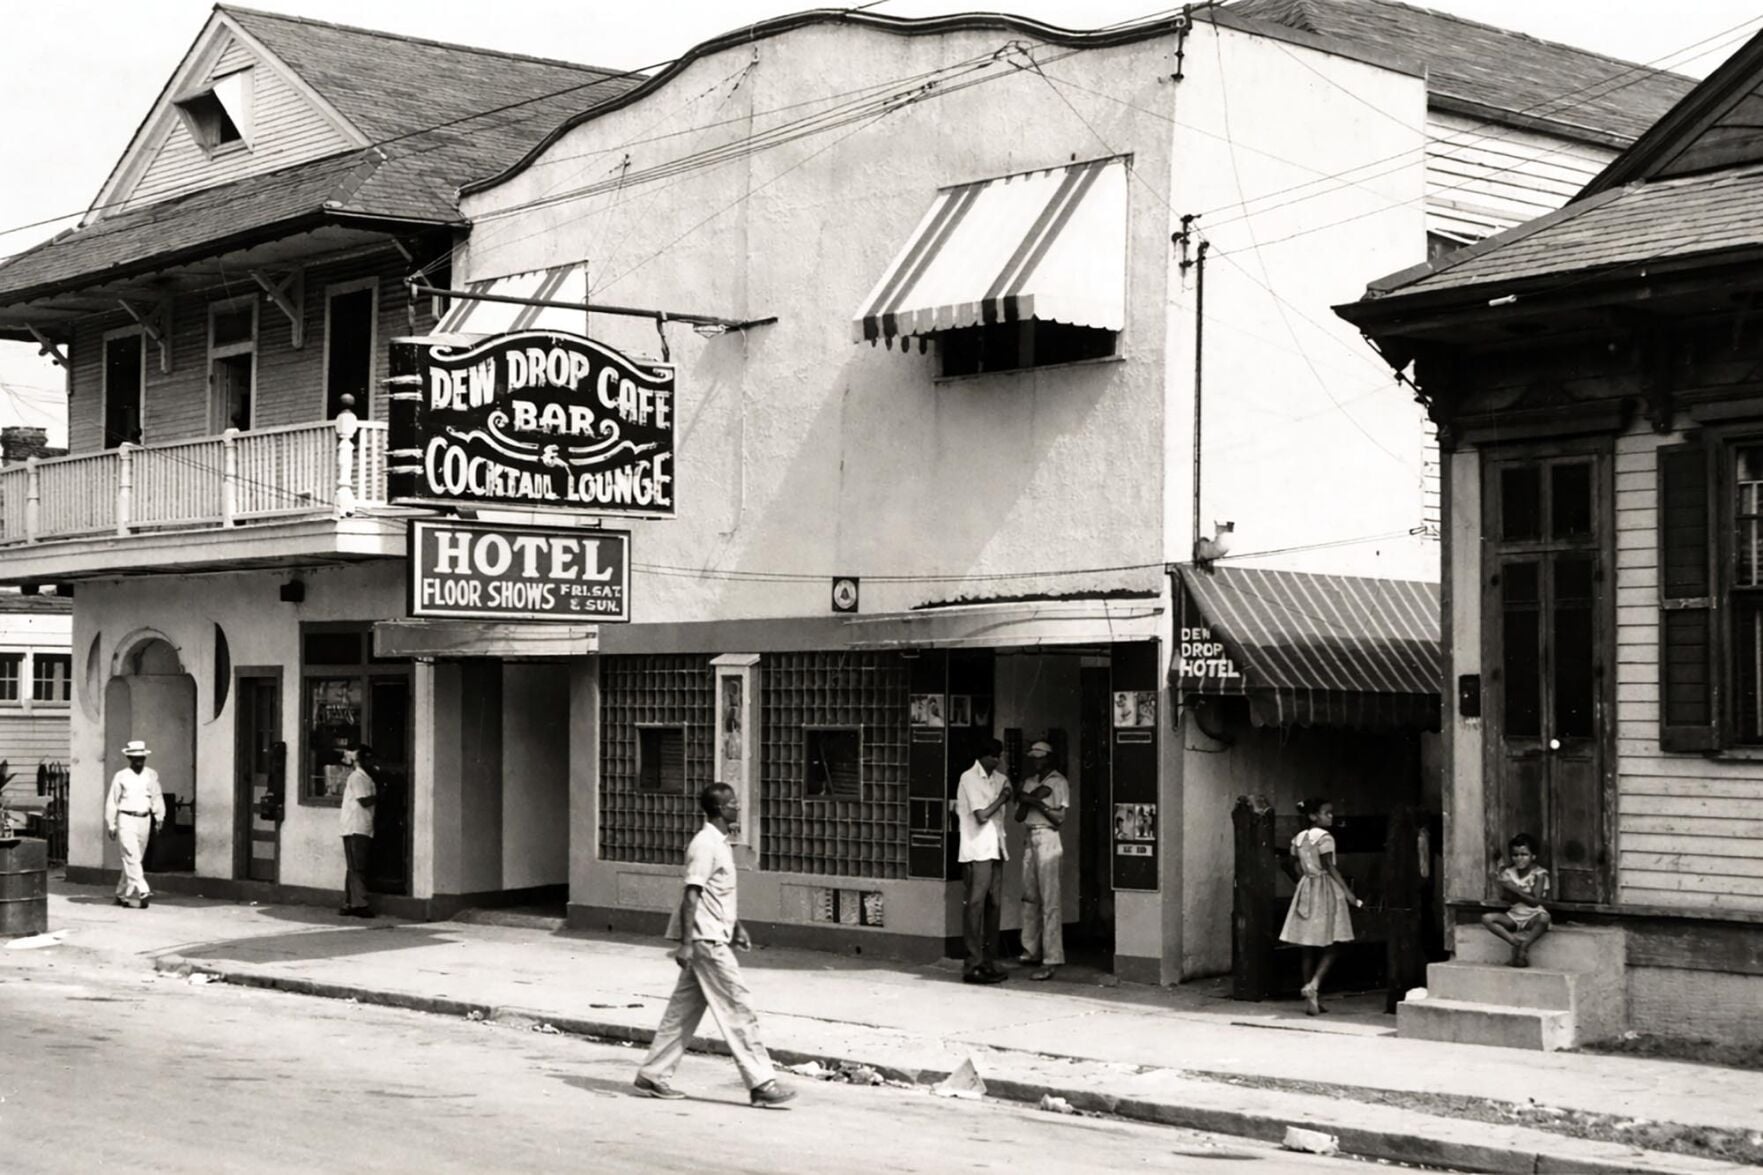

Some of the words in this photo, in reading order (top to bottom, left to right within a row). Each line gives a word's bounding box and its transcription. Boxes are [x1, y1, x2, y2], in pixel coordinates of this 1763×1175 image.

[429, 357, 496, 411] DEW
[506, 348, 590, 393] DROP
[597, 366, 671, 429] CAFE
[512, 400, 596, 438] BAR
[425, 436, 560, 499] COCKTAIL
[564, 452, 671, 506] LOUNGE
[433, 531, 614, 581] HOTEL
[423, 578, 482, 607] FLOOR
[487, 581, 556, 610] SHOWS
[584, 599, 620, 612] SUN.
[1181, 642, 1224, 658] DROP
[1179, 659, 1240, 677] HOTEL
